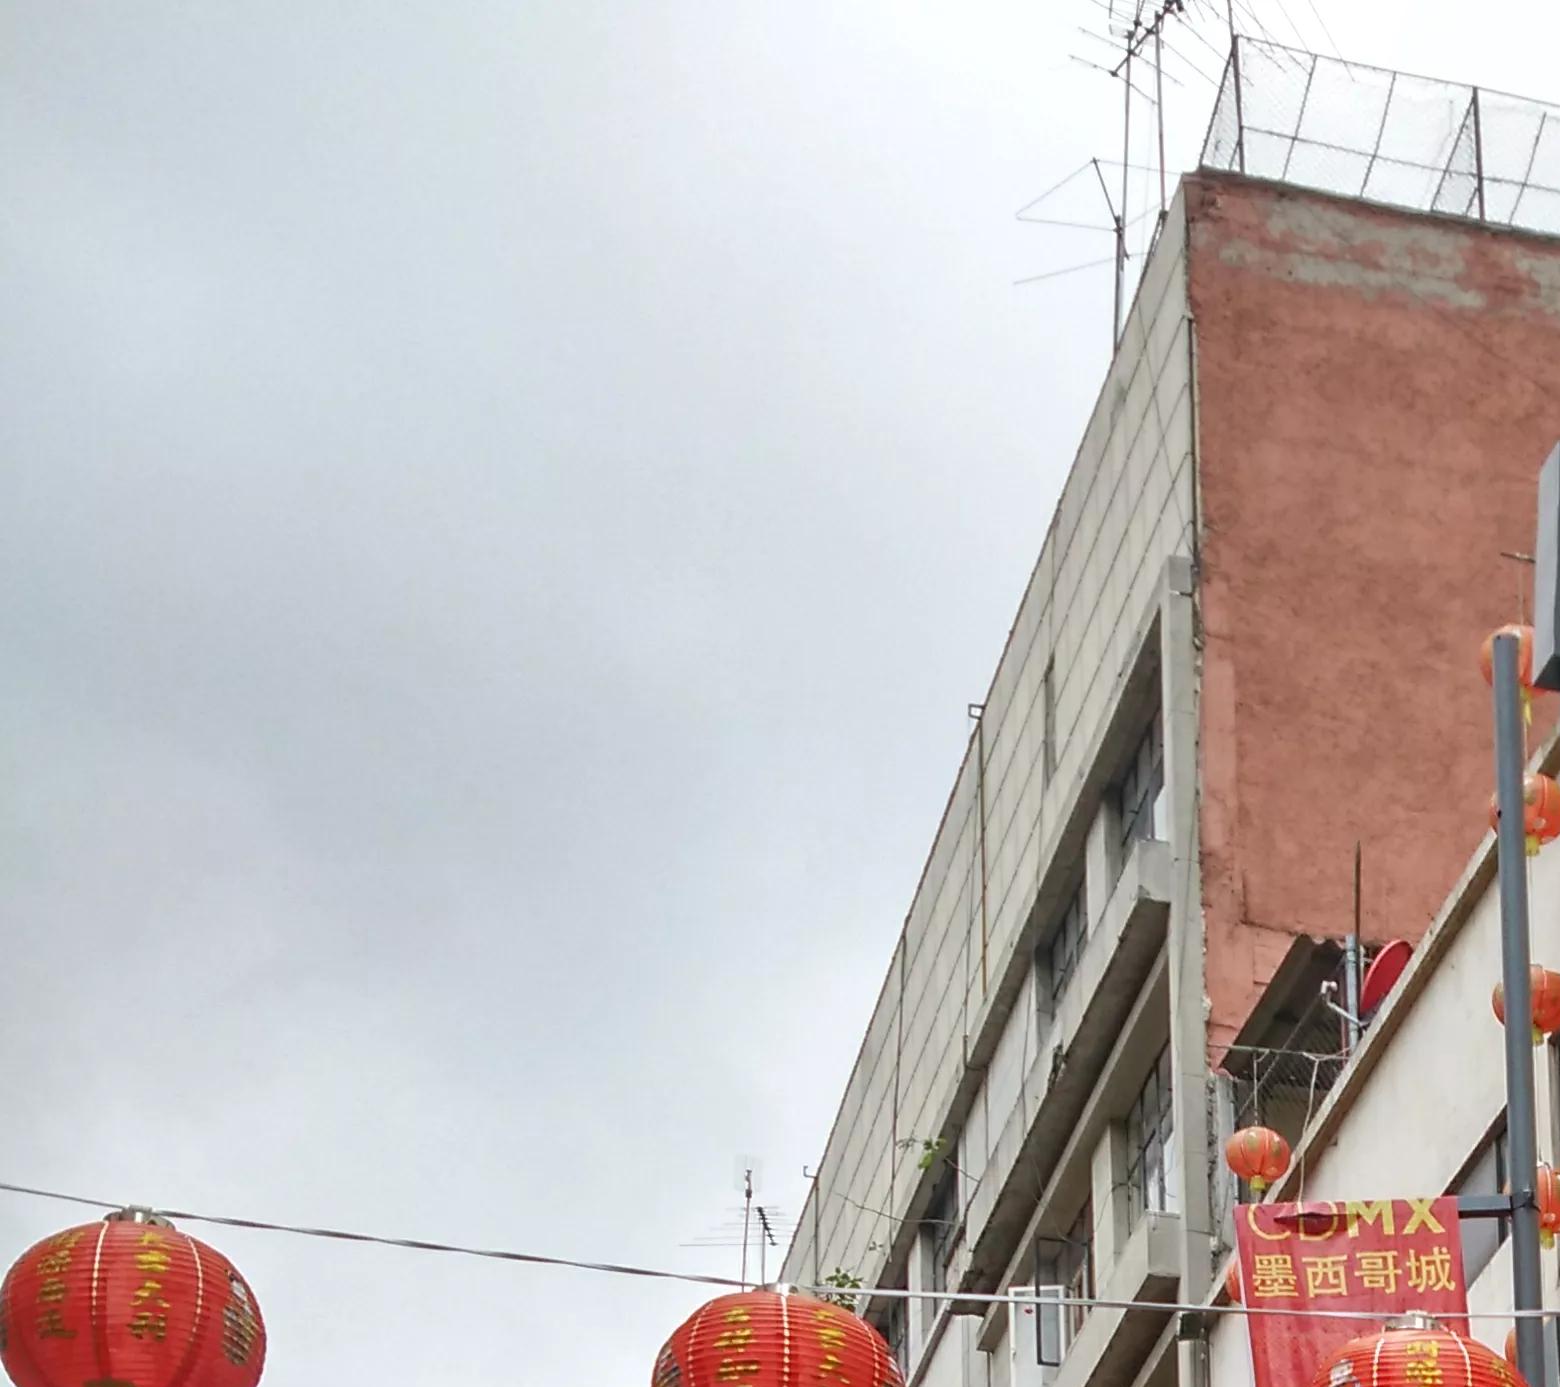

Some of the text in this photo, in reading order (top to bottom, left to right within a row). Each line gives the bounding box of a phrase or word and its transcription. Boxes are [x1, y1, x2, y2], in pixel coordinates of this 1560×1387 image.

[1248, 1198, 1446, 1241] CDMX
[1252, 1247, 1456, 1298] 墨西哥城
